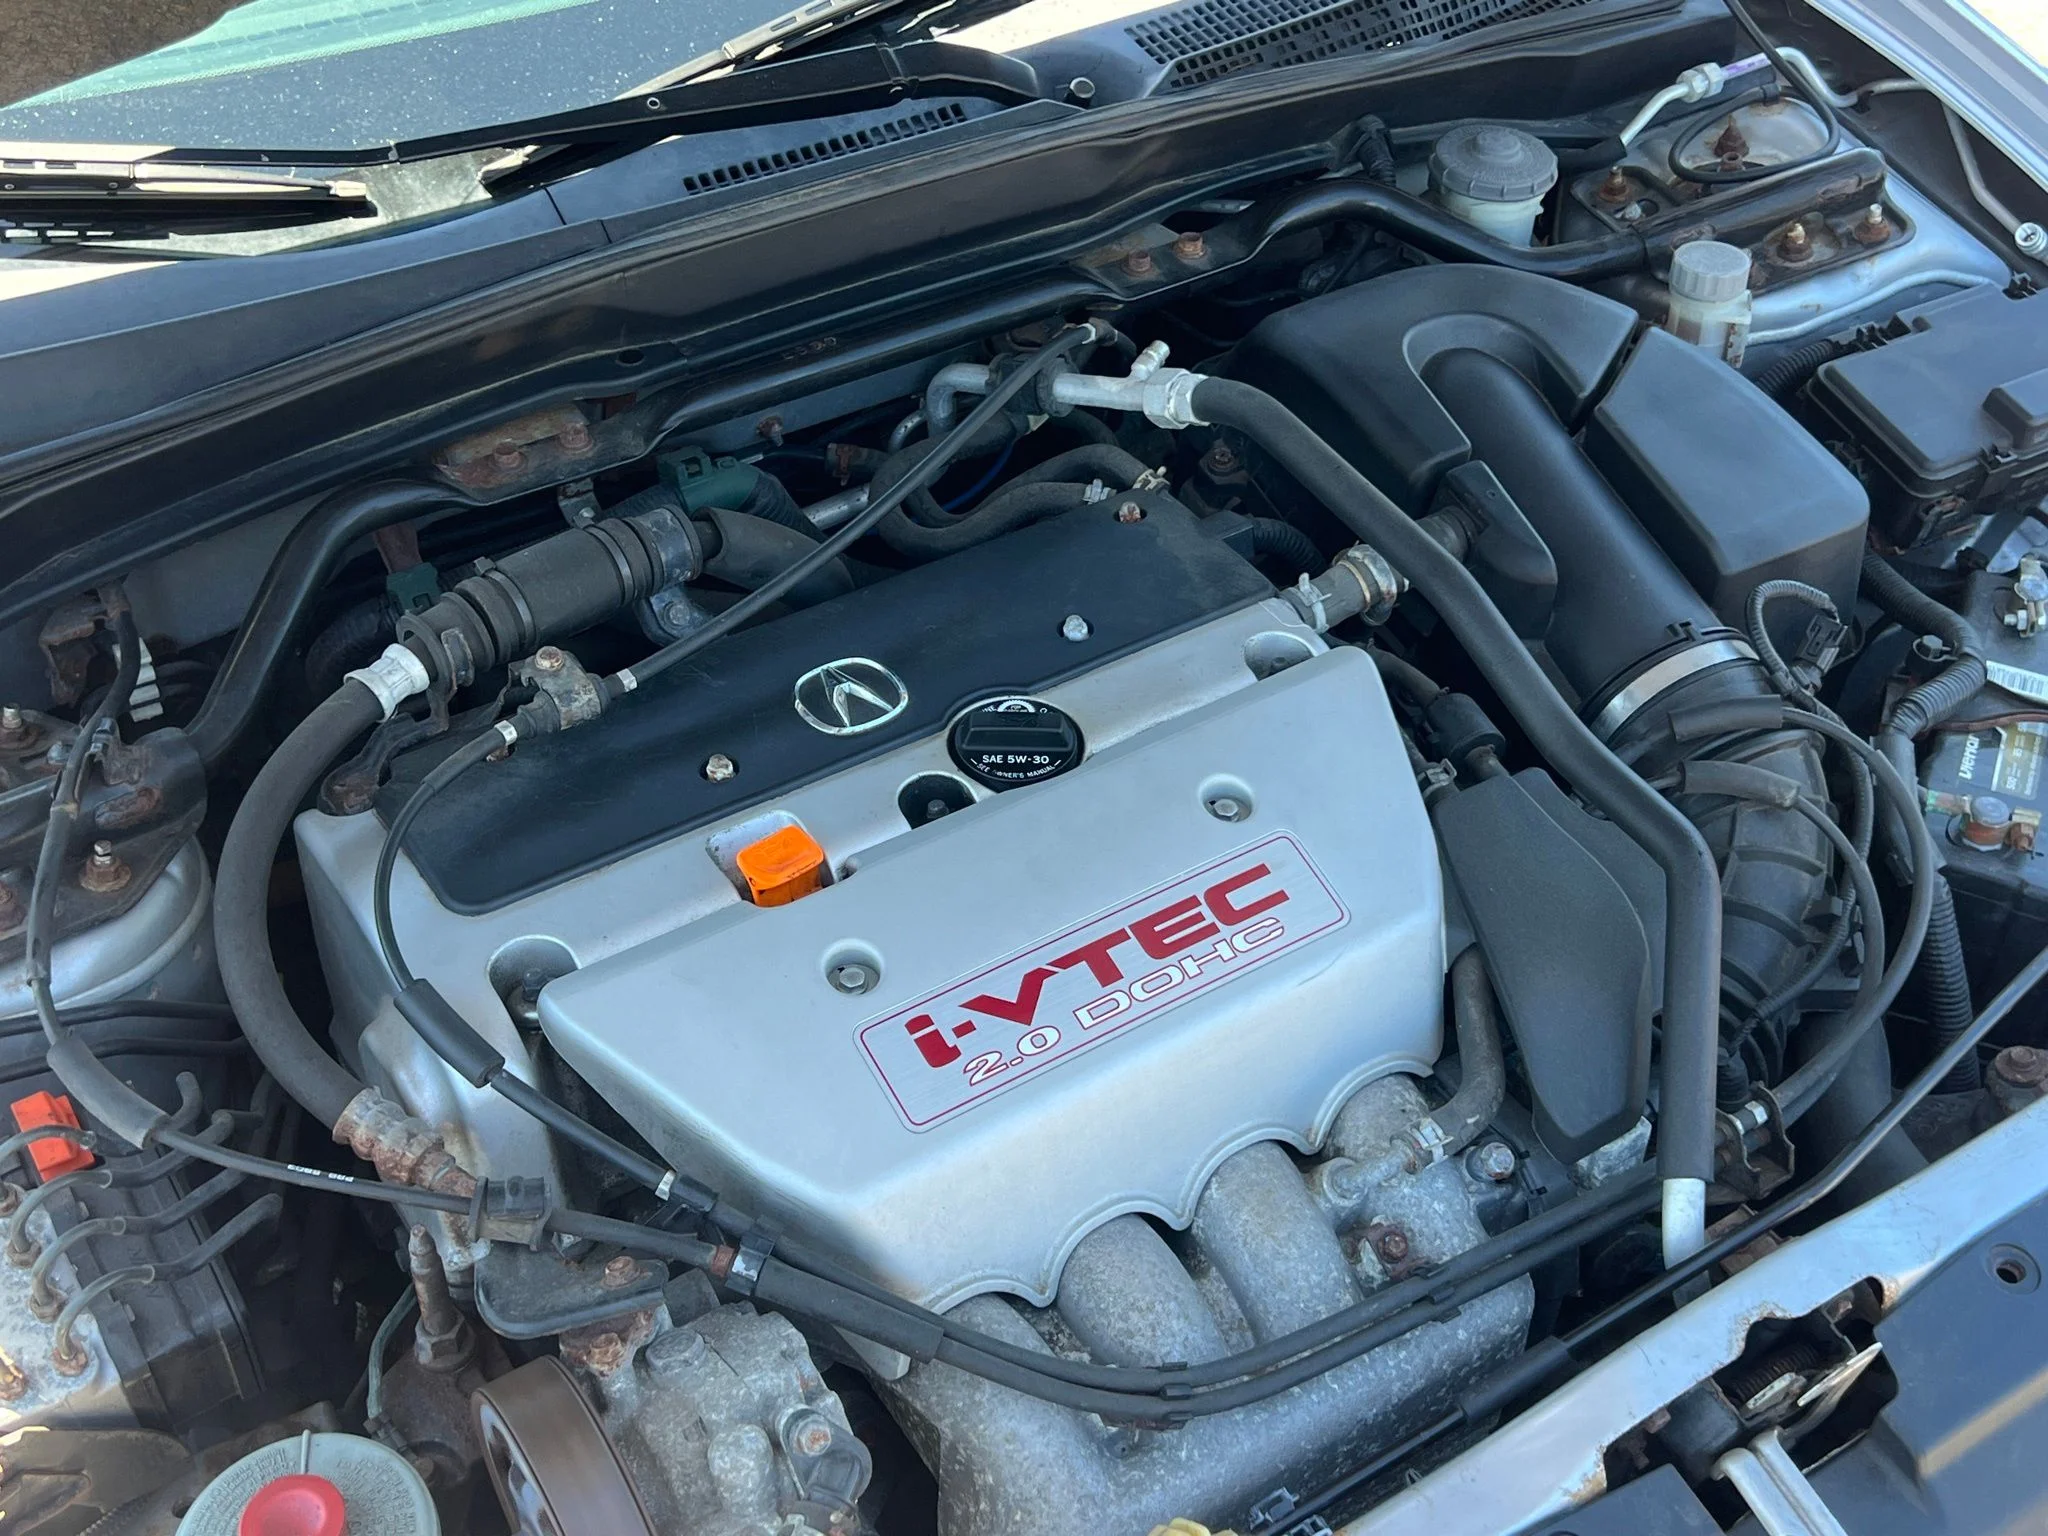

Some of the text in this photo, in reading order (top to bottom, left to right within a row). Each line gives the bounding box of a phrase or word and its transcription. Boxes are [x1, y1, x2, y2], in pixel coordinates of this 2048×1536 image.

[976, 763, 991, 773] SEE
[1026, 765, 1056, 778] MANUAL
[982, 754, 1050, 764] SAE 5W-30
[1958, 733, 1980, 780] DieHar
[904, 863, 1290, 1068] i-VTEC
[963, 917, 1285, 1087] 2.0 DOHC
